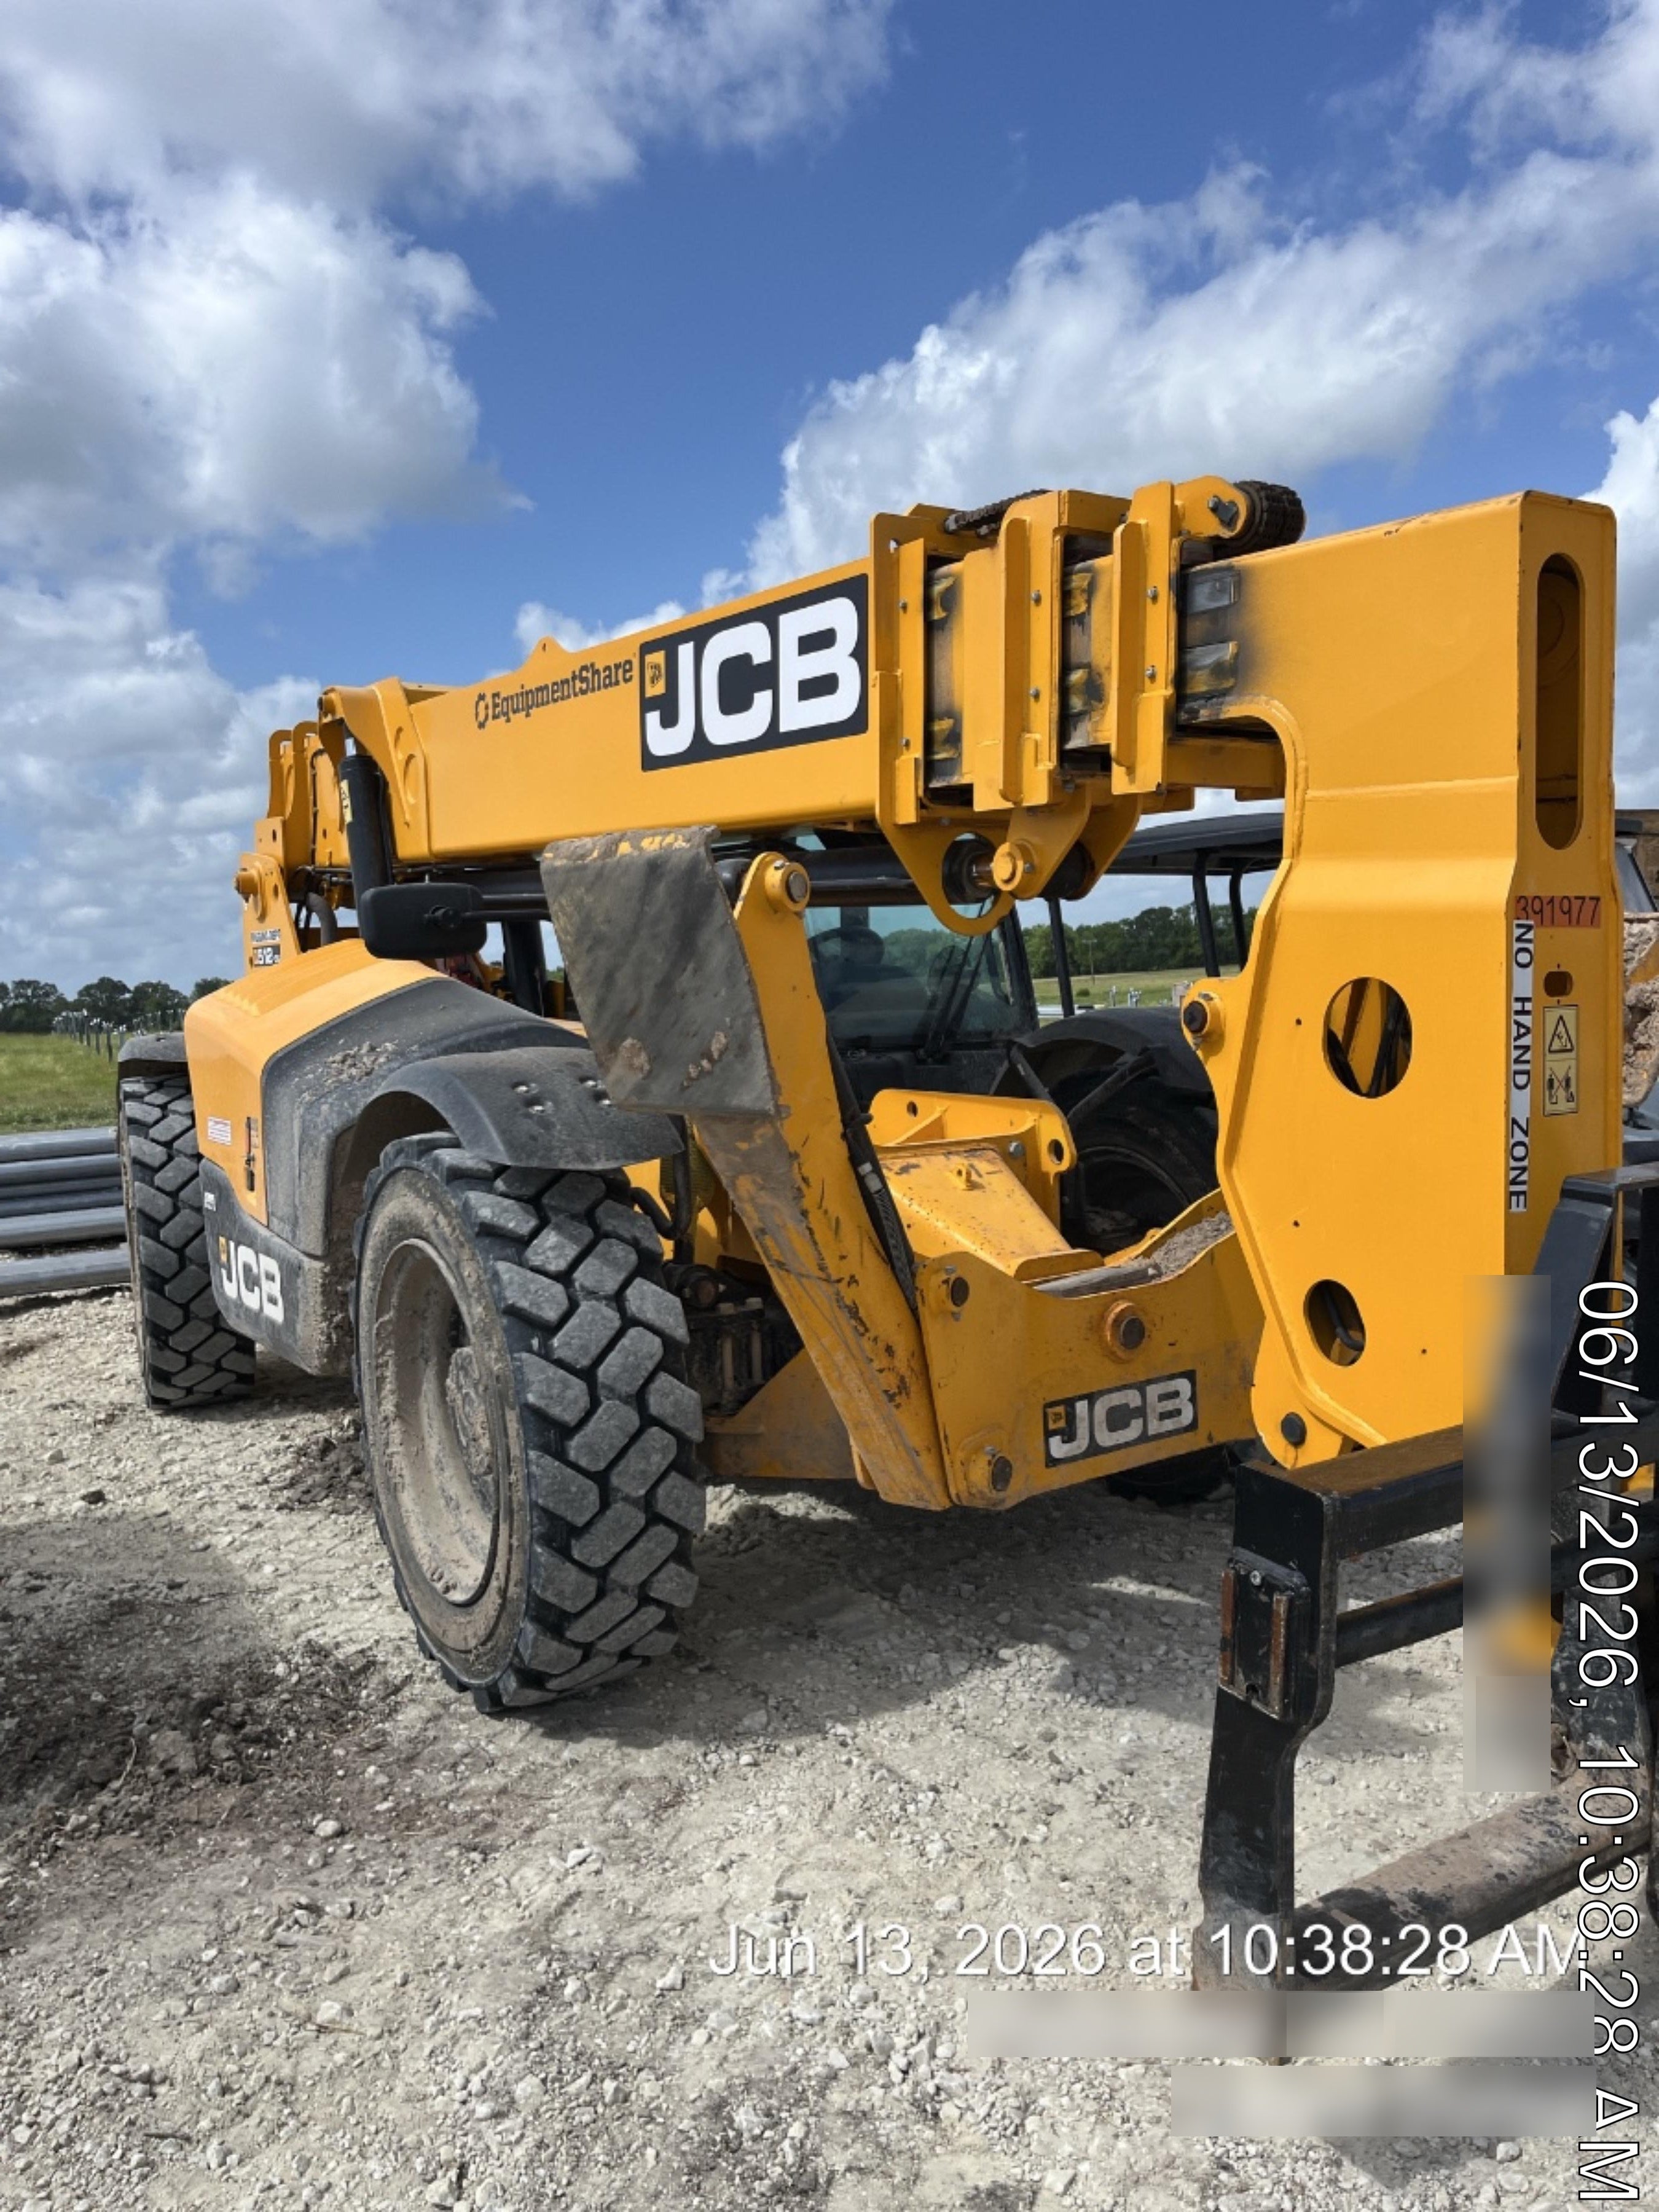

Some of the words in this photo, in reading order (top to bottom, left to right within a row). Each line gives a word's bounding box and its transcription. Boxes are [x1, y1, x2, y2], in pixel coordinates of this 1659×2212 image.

[492, 658, 633, 723] EquipmentShare
[645, 597, 861, 756] JCB
[1515, 923, 1534, 969] NO
[1516, 895, 1601, 926] 391977
[1513, 997, 1533, 1091] HAND
[1509, 1116, 1529, 1210] ZONE
[221, 1241, 284, 1324] JCB
[1048, 1377, 1194, 1459] JCB
